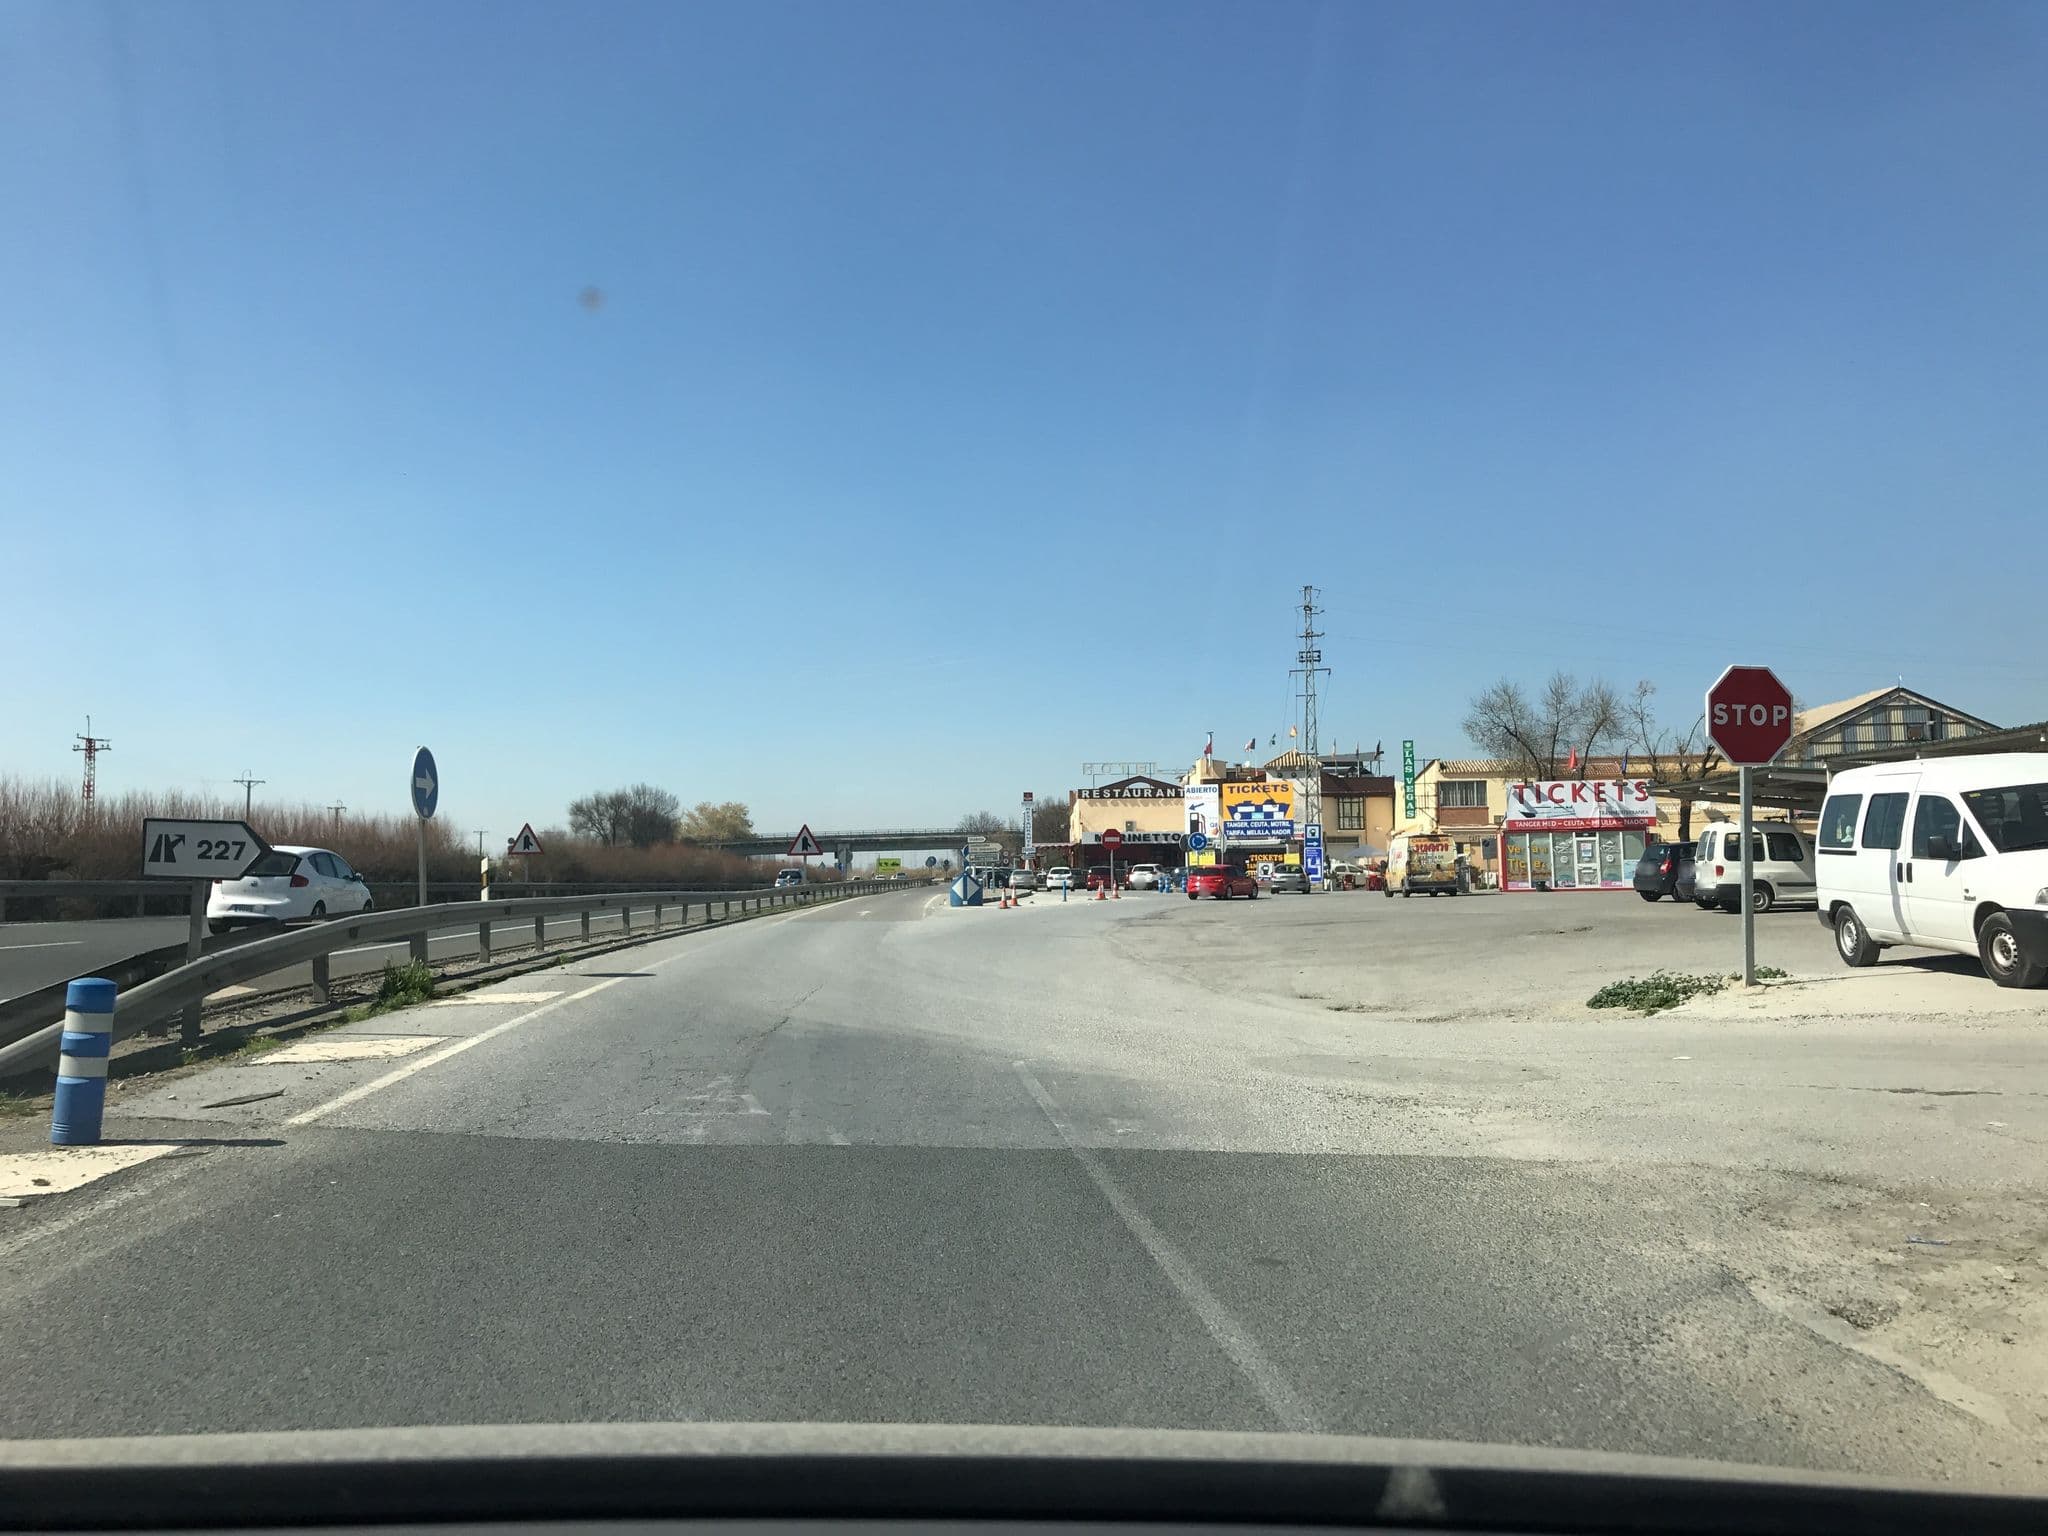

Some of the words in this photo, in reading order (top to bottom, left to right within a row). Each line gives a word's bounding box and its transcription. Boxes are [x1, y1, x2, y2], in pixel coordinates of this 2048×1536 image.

[1713, 703, 1788, 727] STOP
[1404, 750, 1413, 773] LAS
[1081, 787, 1184, 798] RESTAURANT
[1186, 786, 1218, 794] ABIERTO
[1227, 784, 1289, 794] TICKETS
[1513, 781, 1649, 805] TICKETS
[1405, 778, 1415, 818] VEGAS
[1515, 820, 1541, 828] TANGER
[1563, 819, 1585, 827] CEUTA
[1623, 818, 1649, 826] NADOR
[1272, 828, 1291, 836] NADOR
[197, 840, 247, 861] 227
[1249, 854, 1283, 862] TICKETS
